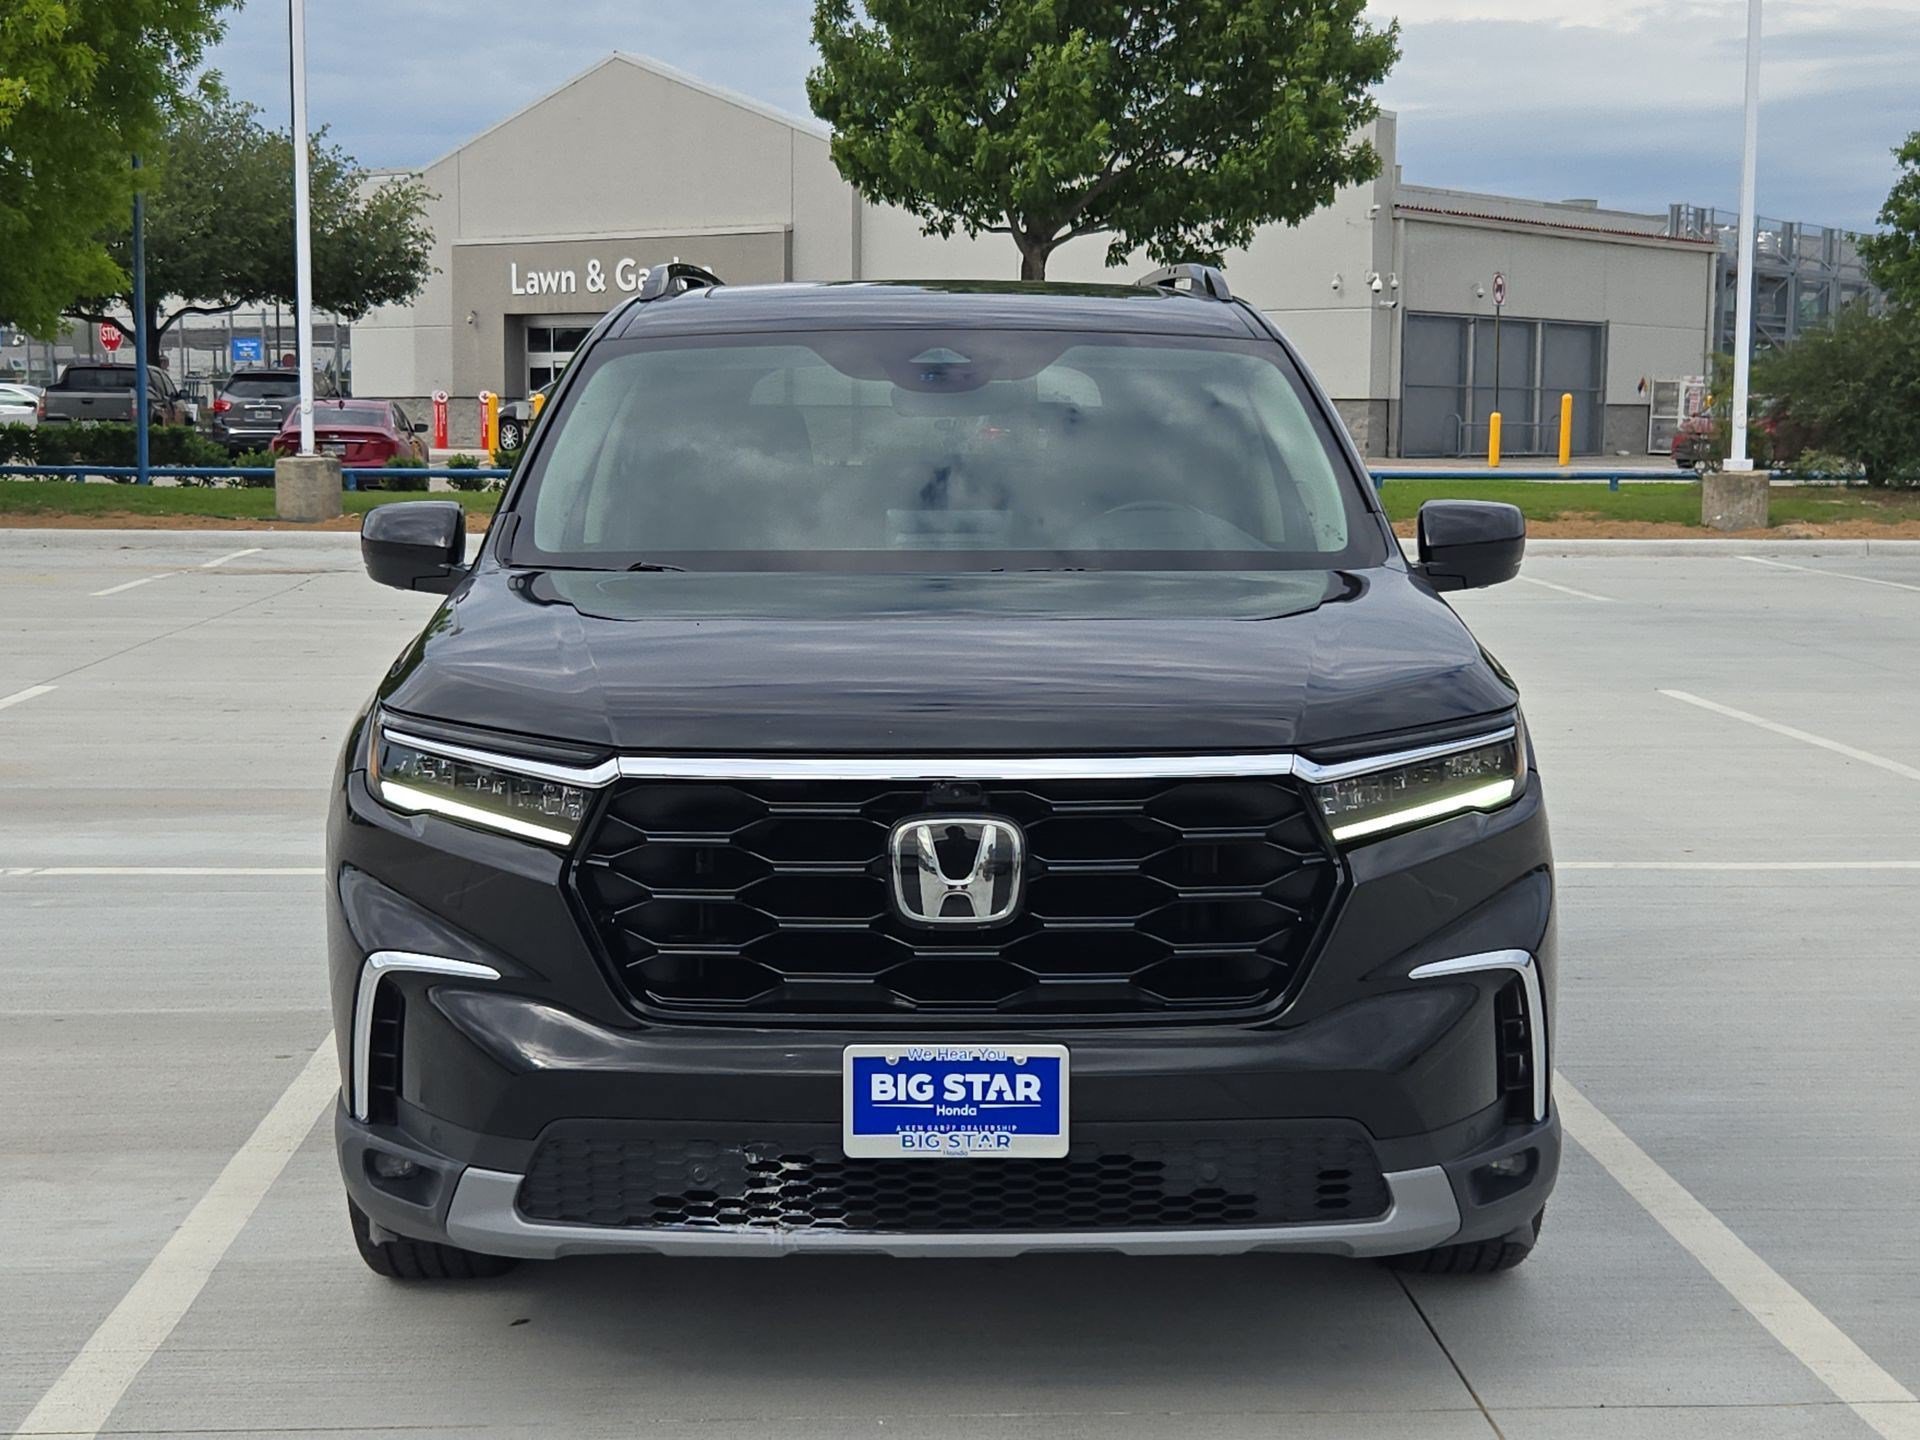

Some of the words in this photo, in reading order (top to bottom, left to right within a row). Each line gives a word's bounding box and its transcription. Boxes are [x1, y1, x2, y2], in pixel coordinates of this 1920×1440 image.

[511, 263, 576, 294] Lawn
[586, 259, 607, 293] &
[101, 327, 121, 341] STOP
[907, 1047, 933, 1060] We
[937, 1047, 973, 1060] Hear
[978, 1047, 1006, 1060] You
[871, 1073, 934, 1101] BIG
[943, 1073, 1041, 1101] STAR
[936, 1103, 977, 1117] Honda
[902, 1134, 940, 1148] BIG
[948, 1134, 1010, 1148] STAR
